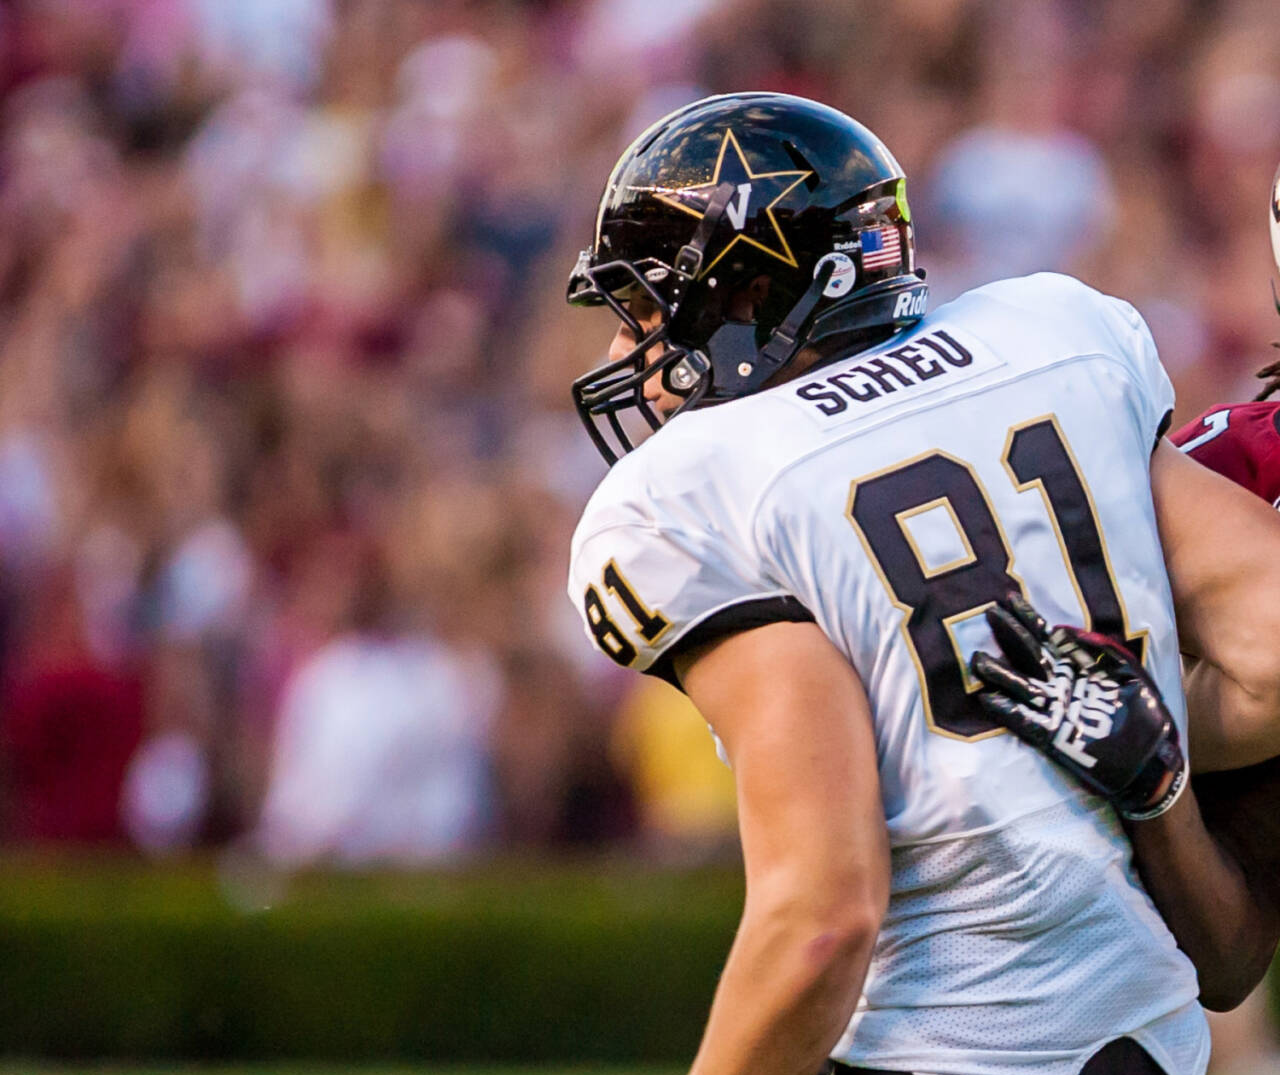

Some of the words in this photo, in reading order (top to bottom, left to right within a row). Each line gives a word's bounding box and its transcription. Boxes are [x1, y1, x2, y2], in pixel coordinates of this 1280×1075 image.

[726, 183, 752, 230] V
[796, 330, 973, 417] SCHEU
[584, 557, 675, 668] 81
[845, 413, 1149, 743] 81
